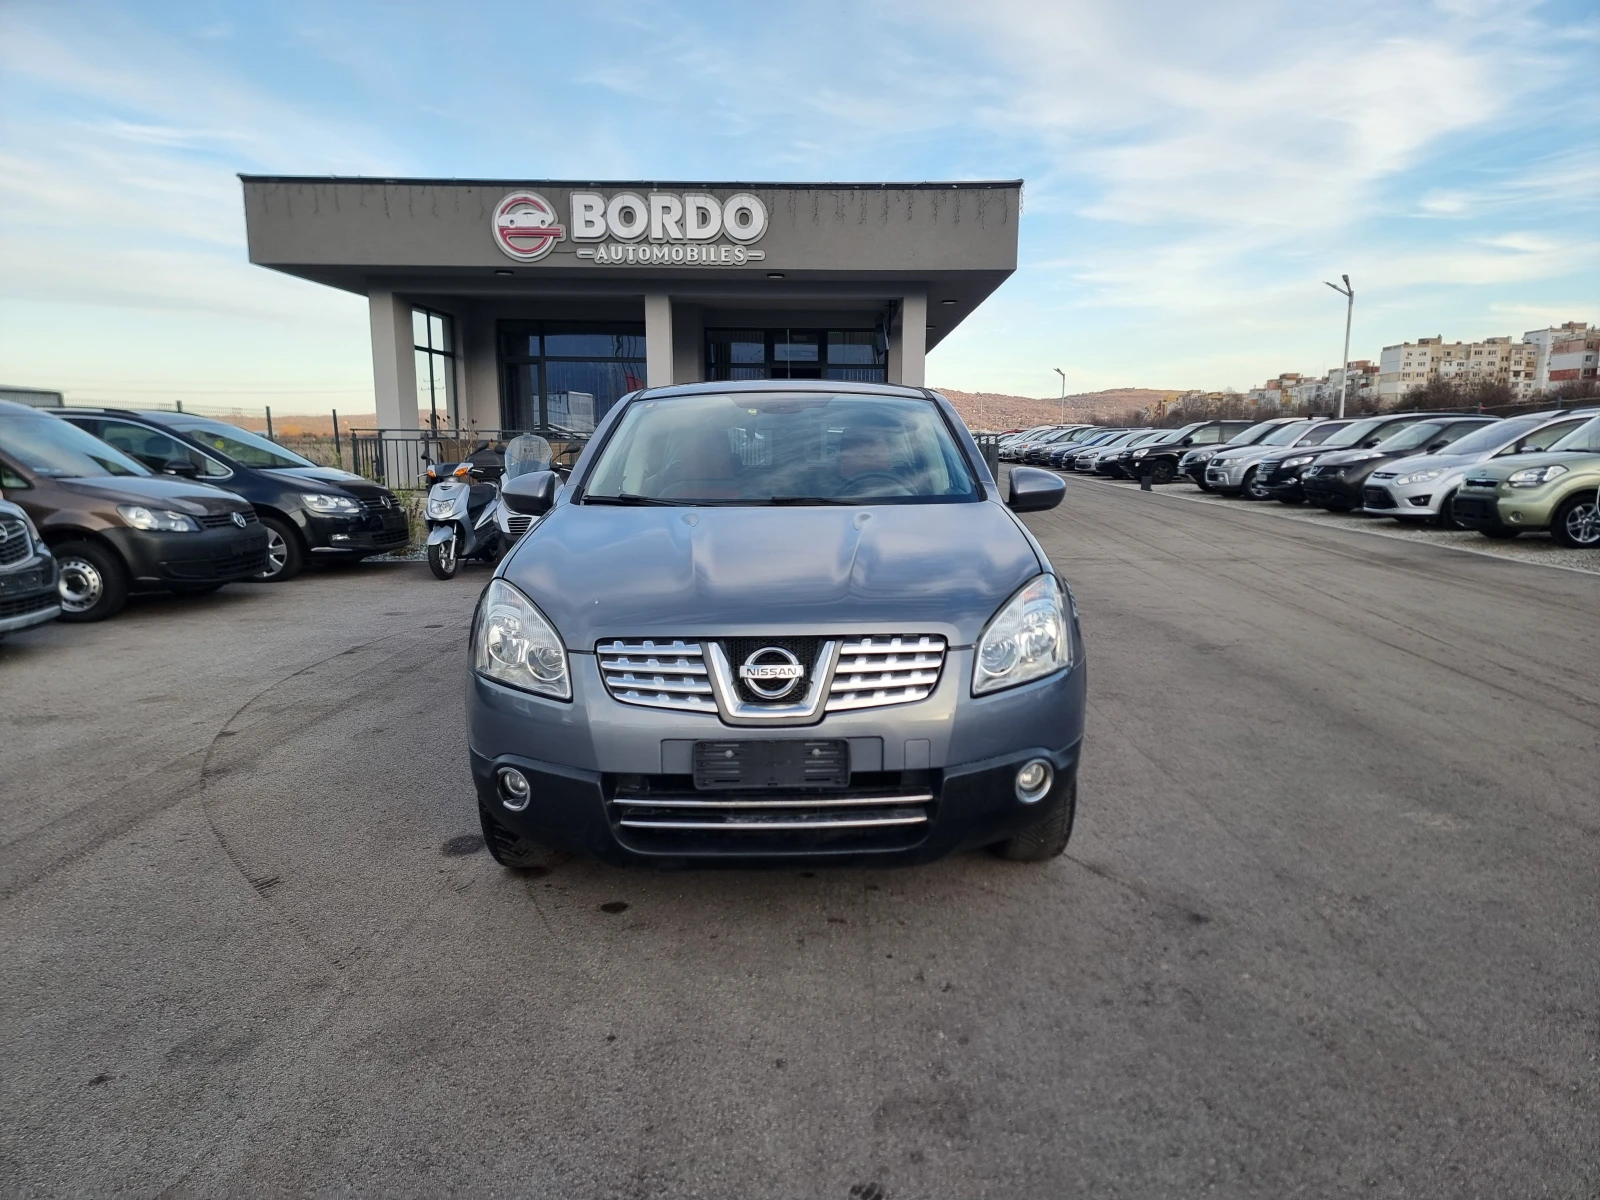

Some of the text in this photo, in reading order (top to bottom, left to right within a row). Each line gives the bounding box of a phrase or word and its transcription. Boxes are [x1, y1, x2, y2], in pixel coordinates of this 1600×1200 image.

[572, 194, 765, 241] BORDO
[596, 245, 745, 262] AUTOMOBILES
[746, 667, 797, 676] NISSAN
